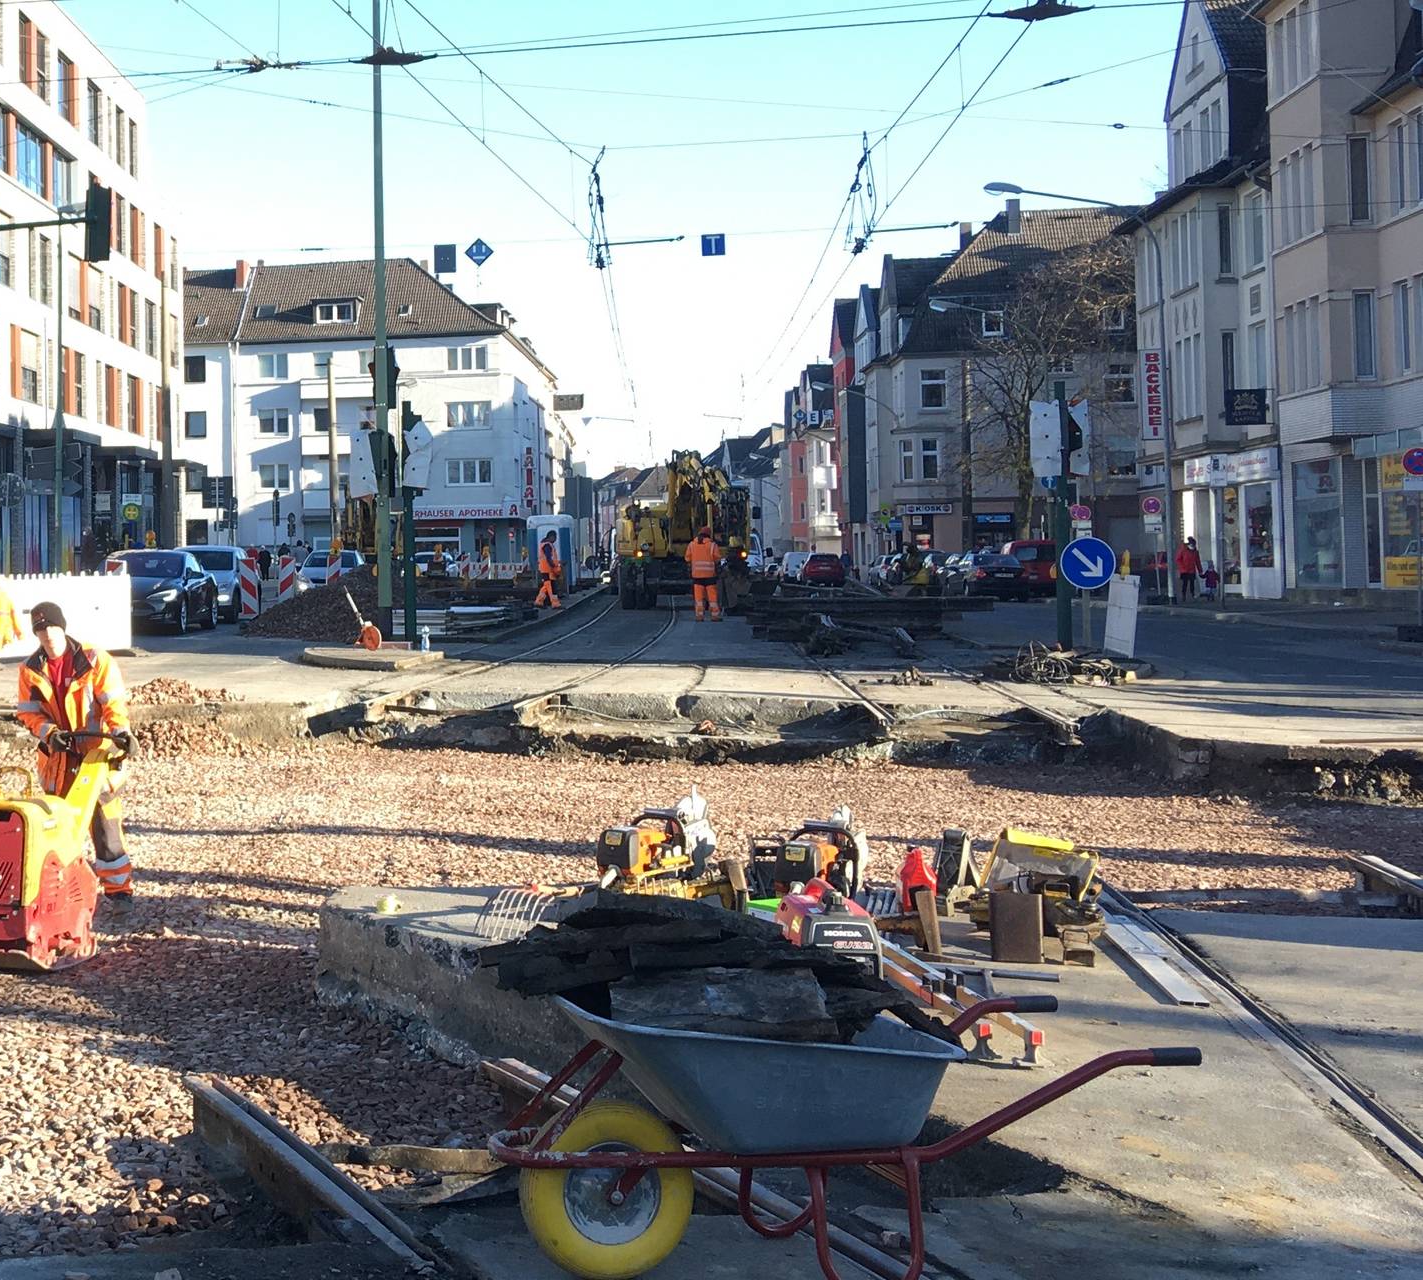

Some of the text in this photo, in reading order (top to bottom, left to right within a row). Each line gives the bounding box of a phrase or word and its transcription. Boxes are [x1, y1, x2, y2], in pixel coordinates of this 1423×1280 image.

[706, 236, 721, 254] T
[1144, 352, 1162, 437] BÄCKEREI
[412, 509, 455, 518] RHAUSER
[458, 508, 504, 518] APOTHEKE
[915, 504, 942, 512] KIOSK
[823, 930, 863, 938] HONDA
